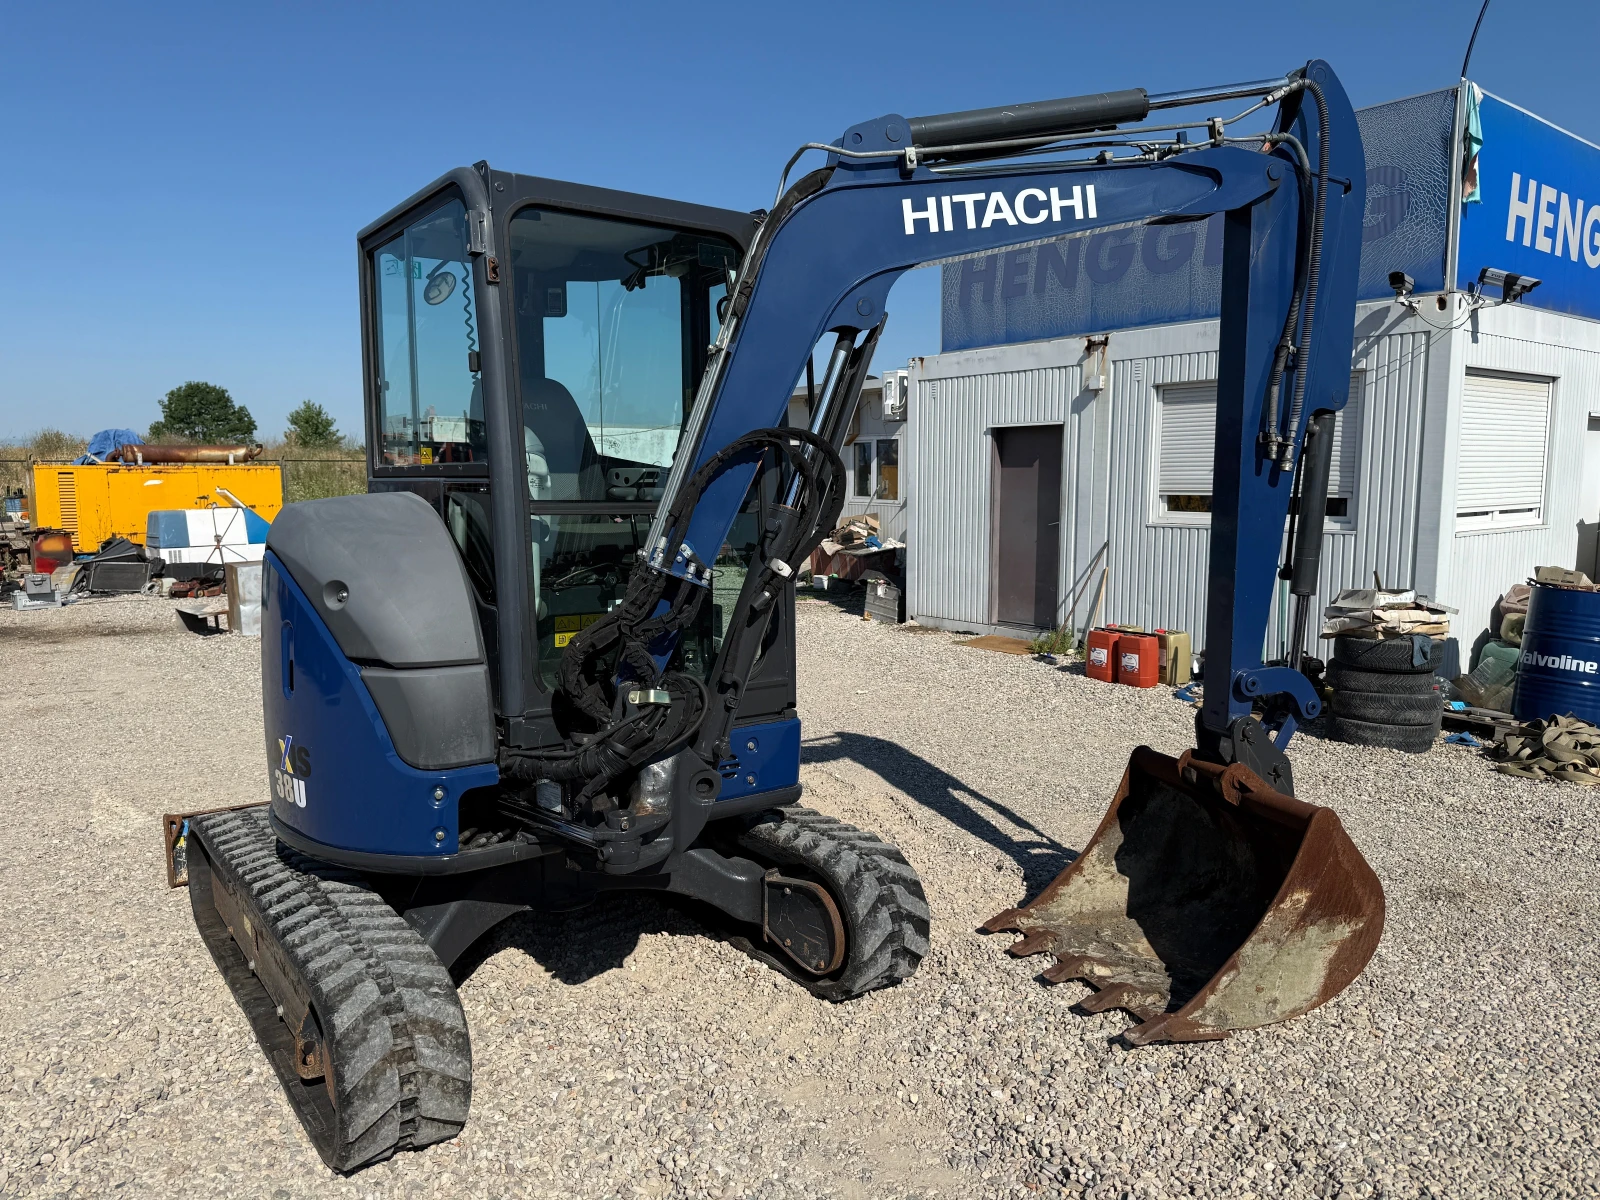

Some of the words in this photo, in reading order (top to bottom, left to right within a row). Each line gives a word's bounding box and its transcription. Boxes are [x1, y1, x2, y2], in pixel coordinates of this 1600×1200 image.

[902, 184, 1098, 235] HITACHI
[1505, 171, 1600, 269] HENG
[274, 768, 307, 808] 38U
